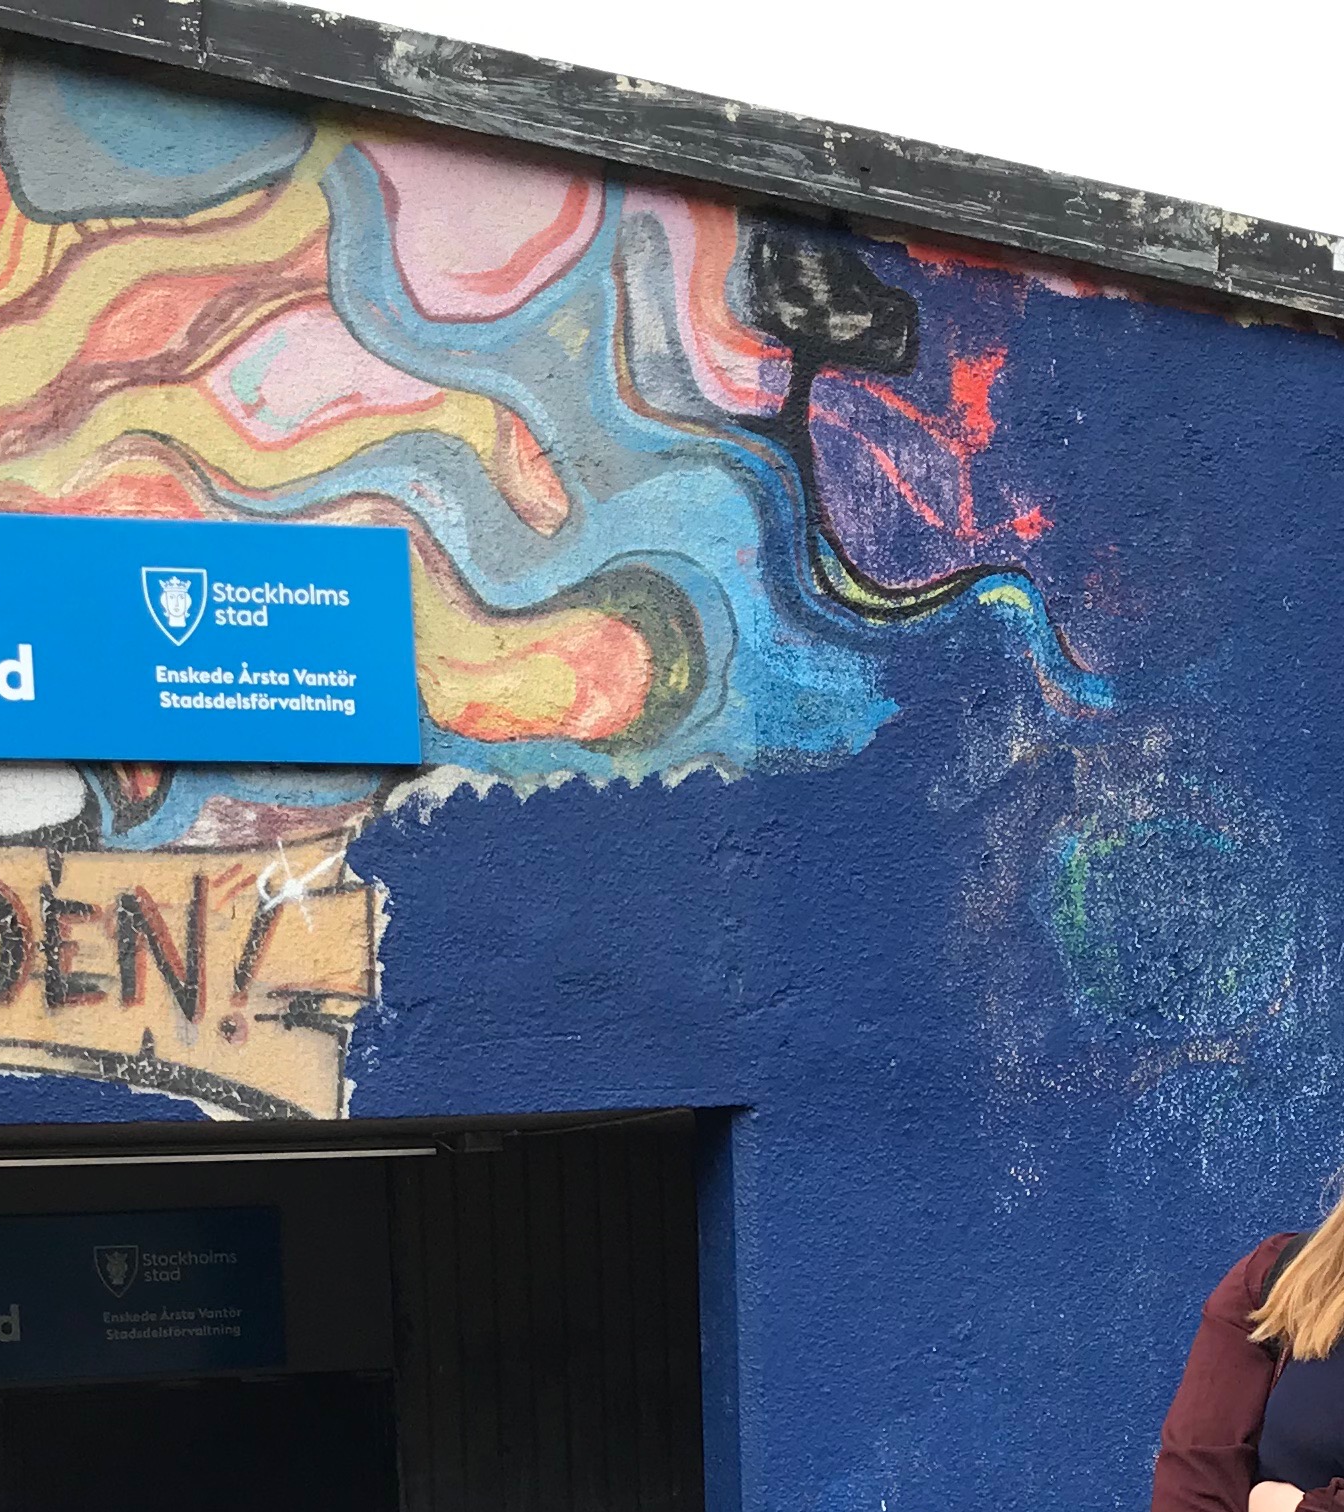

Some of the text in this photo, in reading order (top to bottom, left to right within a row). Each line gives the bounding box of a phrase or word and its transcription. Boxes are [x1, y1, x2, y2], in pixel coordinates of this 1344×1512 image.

[212, 582, 351, 607] Stockholms
[214, 605, 270, 627] stad
[155, 661, 358, 688] Enskede Årsta Vantör
[159, 690, 356, 716] Stadsdelsförvaltning
[142, 1250, 238, 1267] Stockholms
[144, 1266, 181, 1283] stad
